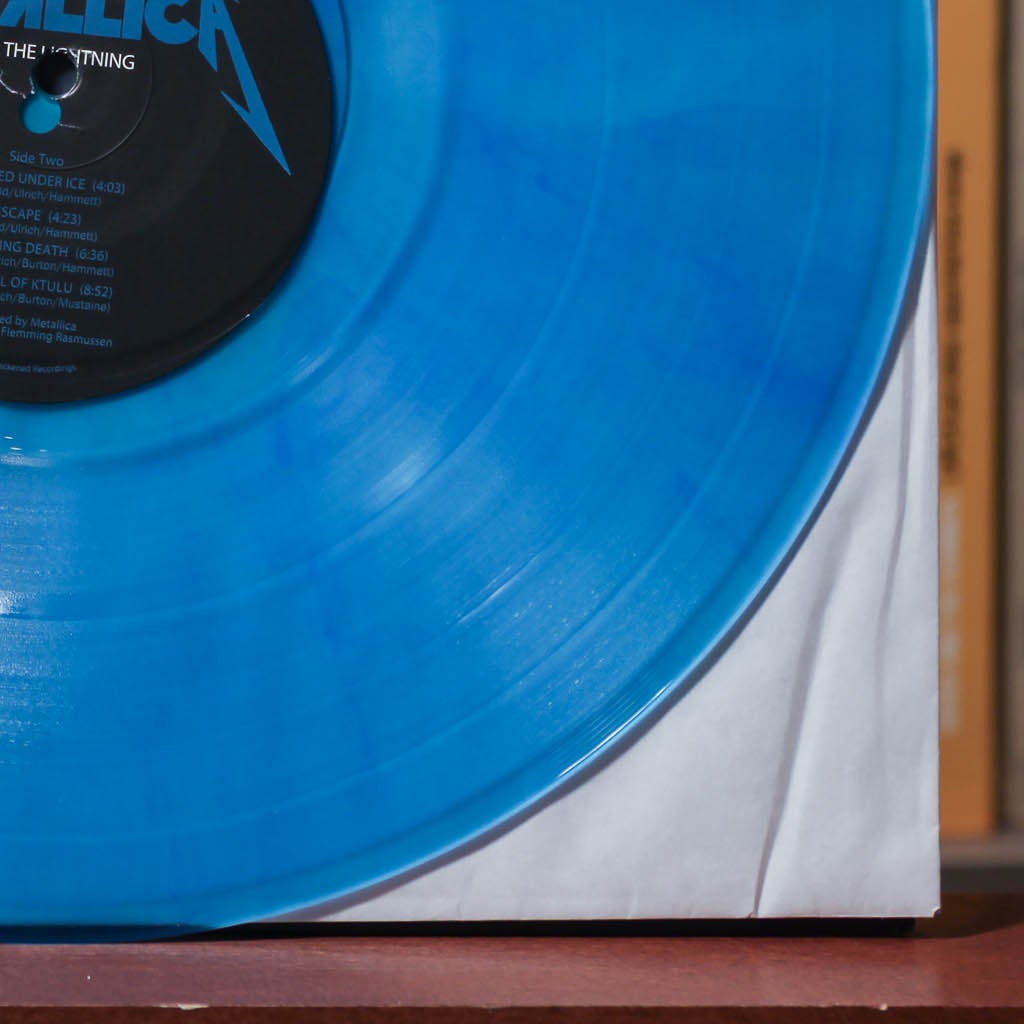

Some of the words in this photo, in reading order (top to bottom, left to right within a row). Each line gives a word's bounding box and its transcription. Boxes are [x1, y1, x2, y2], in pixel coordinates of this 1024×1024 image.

[3, 41, 37, 60] THE
[9, 149, 36, 164] Side
[39, 153, 65, 167] Two
[18, 173, 63, 189] UNDER
[66, 177, 87, 191] ICE
[92, 180, 126, 195] (4:03)
[48, 211, 81, 226] (4:23)
[25, 242, 69, 257] DEATH
[10, 276, 29, 289] OF
[31, 279, 73, 294] KTULU
[80, 283, 113, 299] (8:52)
[15, 314, 28, 328] by
[30, 317, 78, 332] Metallica
[1, 326, 54, 344] Flemming
[55, 333, 113, 348] Rasmussen
